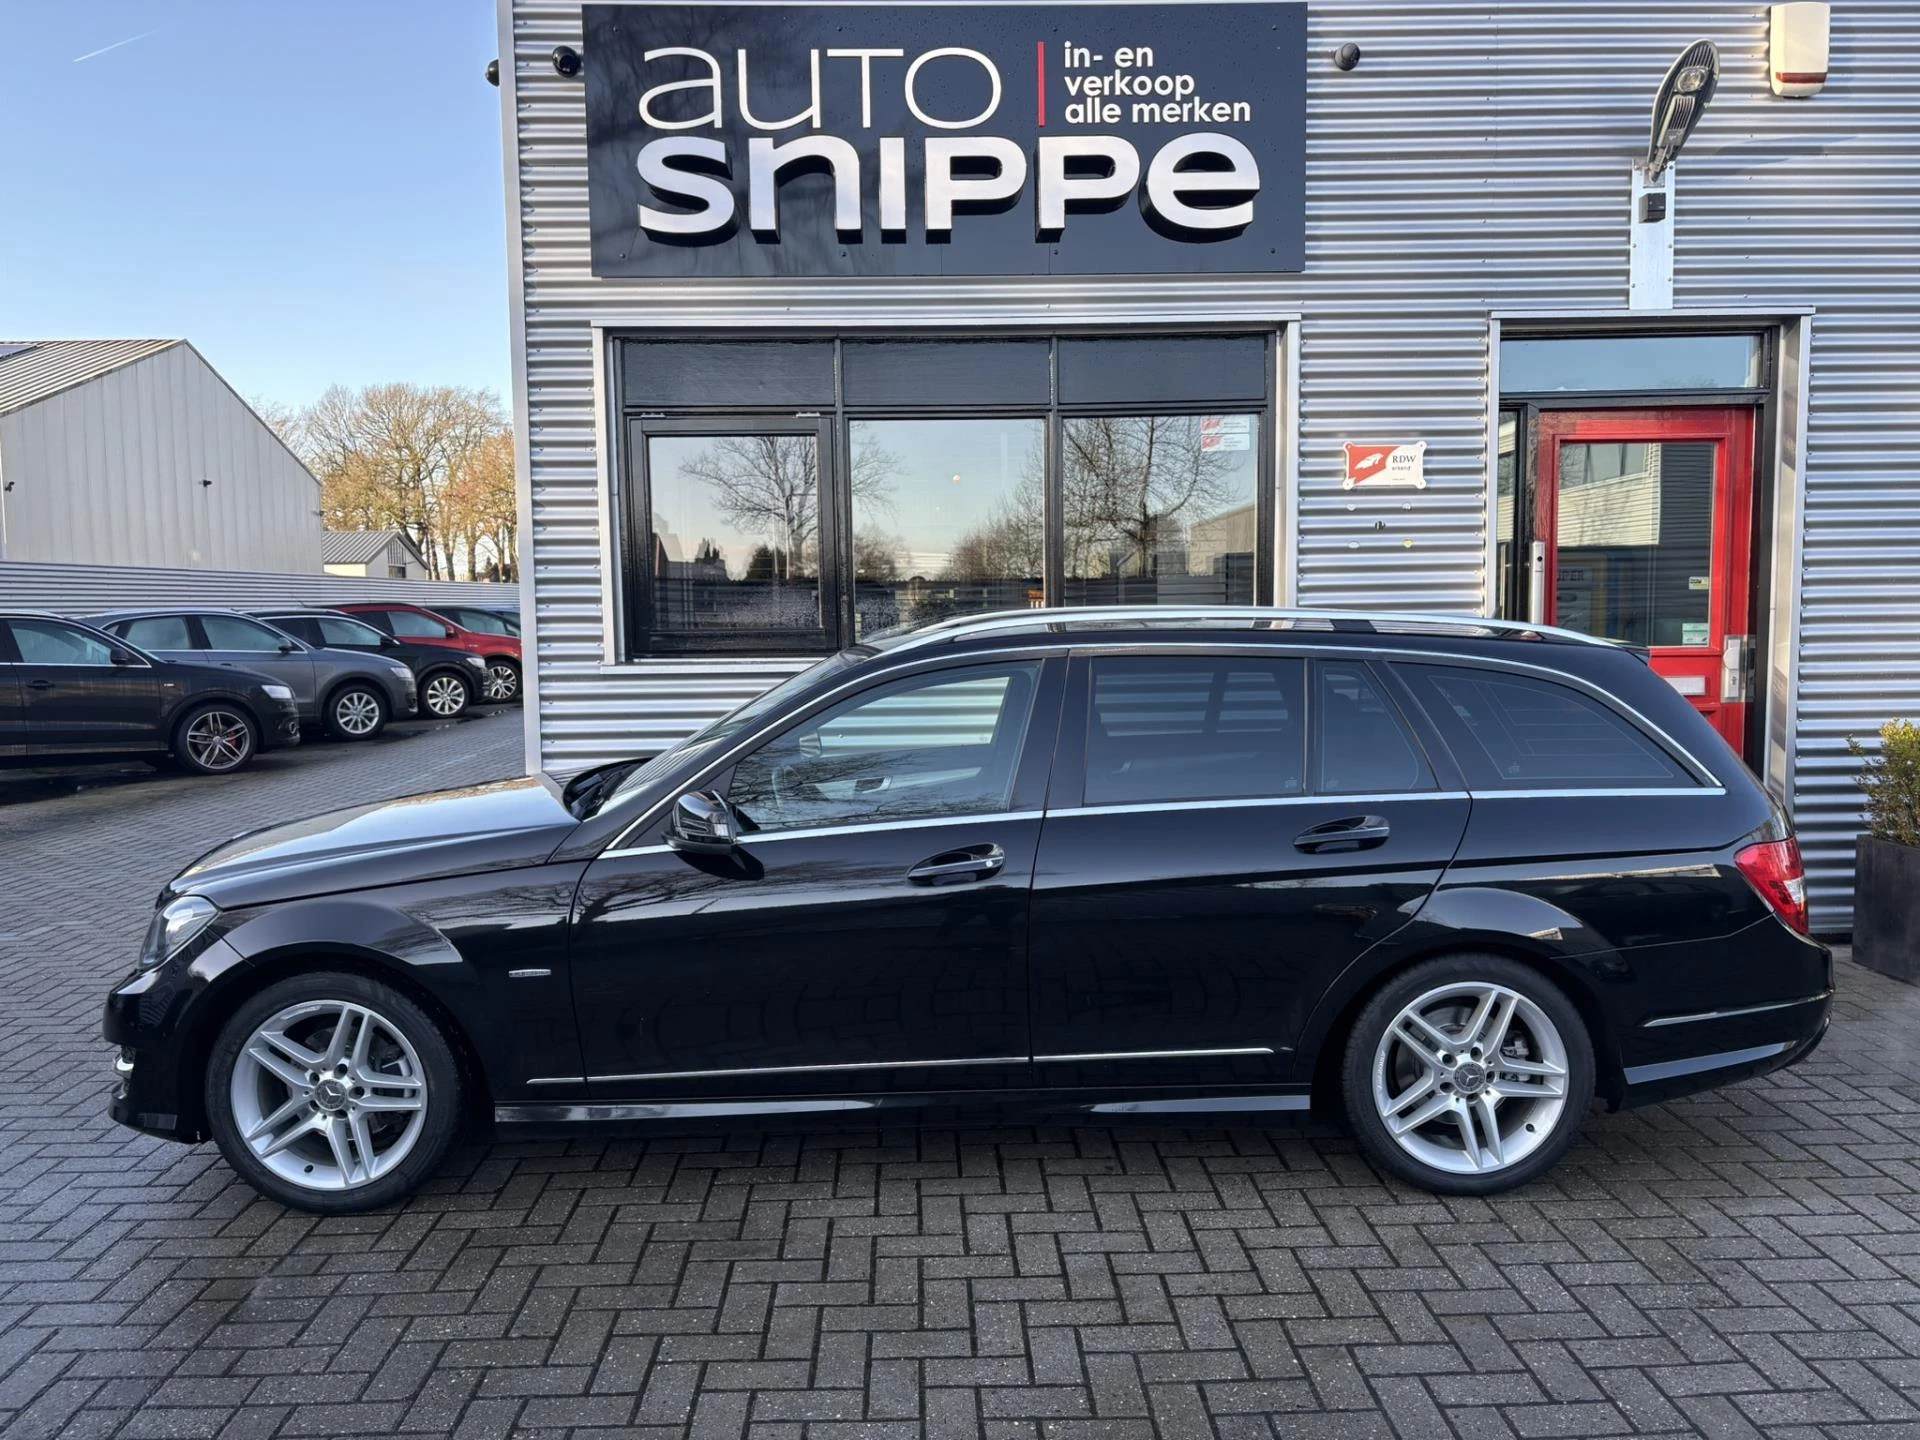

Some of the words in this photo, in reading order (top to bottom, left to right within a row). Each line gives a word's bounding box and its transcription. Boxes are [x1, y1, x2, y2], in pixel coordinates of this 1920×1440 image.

[1064, 41, 1103, 68] in-
[1114, 46, 1153, 68] en
[1064, 69, 1195, 101] verkoop
[1065, 97, 1122, 124] alle
[1132, 96, 1251, 123] merken
[1392, 455, 1416, 463] RDW
